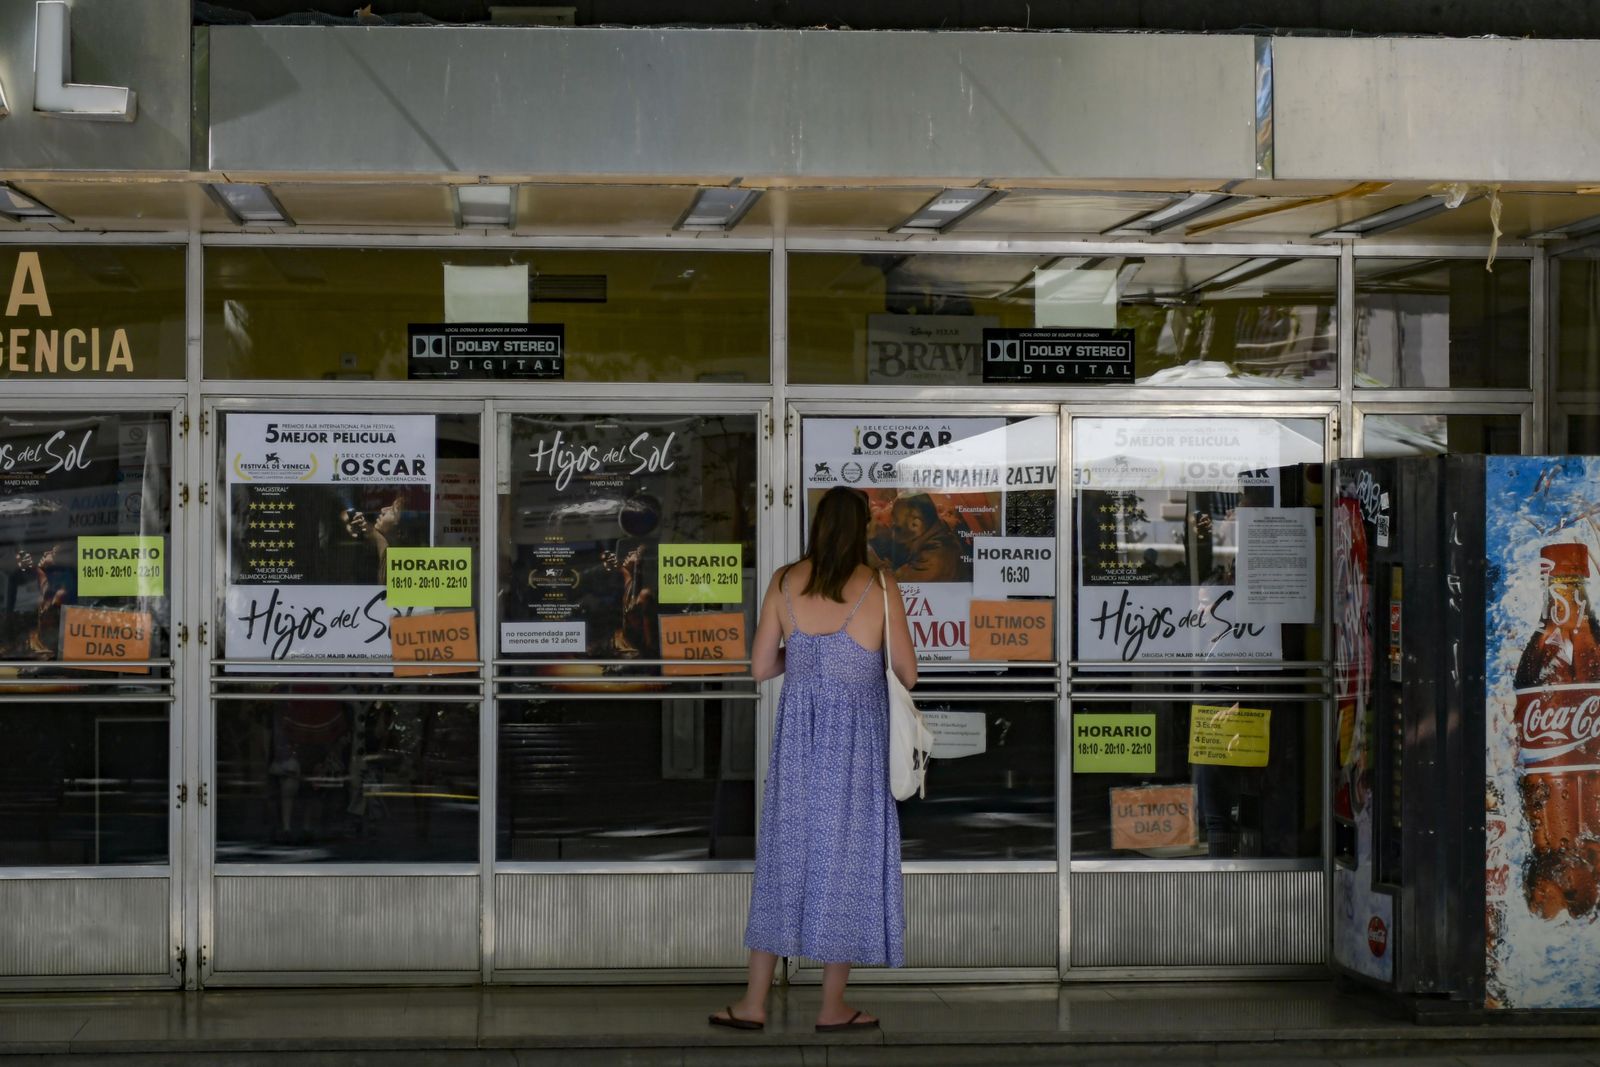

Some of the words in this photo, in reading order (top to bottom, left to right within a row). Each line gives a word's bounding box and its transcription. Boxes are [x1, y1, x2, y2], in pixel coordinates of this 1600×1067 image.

[5, 252, 52, 316] A
[0, 328, 134, 373] ENCIA
[456, 341, 500, 352] DOLBY
[503, 341, 555, 352] STEREO
[1029, 345, 1072, 356] DOLBY
[1076, 346, 1126, 357] STEREO
[450, 360, 560, 370] DIGITAL
[1023, 364, 1131, 375] DIGITAL
[265, 423, 280, 443] 5
[280, 432, 328, 443] MEJOR
[333, 432, 396, 443] PELICULA
[863, 431, 952, 450] OSCAR
[1114, 428, 1128, 447] 5
[1129, 436, 1175, 447] MEJOR
[1179, 436, 1241, 447] PELICULA
[17, 443, 42, 462] del
[44, 430, 93, 474] Sol
[341, 458, 426, 476] OSCAR
[529, 430, 600, 491] Hijos
[602, 445, 626, 463] del
[629, 431, 675, 475] Sol
[82, 548, 160, 560] HORARIO
[977, 548, 1052, 560] HORARIO
[391, 559, 468, 572] HORARIO
[662, 556, 738, 568] HORARIO
[82, 566, 104, 578] 18:10
[110, 566, 132, 578] 20:10
[138, 566, 160, 578] 22:10
[663, 573, 684, 585] 18:10
[690, 573, 712, 585] 20:10
[718, 573, 738, 585] 22:10
[1000, 566, 1030, 583] 16:30
[391, 576, 412, 589] 18:10
[418, 576, 440, 589] 20:10
[446, 576, 468, 589] 22:10
[239, 588, 328, 661] Hijos
[330, 605, 361, 629] del
[974, 615, 1046, 630] ULTIMOS
[1090, 589, 1176, 662] Hijos
[1178, 609, 1206, 629] del
[69, 623, 145, 641] ULTIMOS
[395, 626, 470, 647] ULTIMOS
[666, 627, 739, 646] ULTIMOS
[990, 633, 1029, 646] DIAS
[85, 642, 126, 657] DIAS
[414, 646, 455, 662] DIAS
[684, 645, 724, 661] DIAS
[1078, 726, 1152, 738] HORARIO
[1078, 743, 1098, 755] 18:10
[1104, 743, 1125, 755] 20:10
[1131, 743, 1152, 755] 22:10
[1117, 802, 1189, 819] ULTIMOS
[1134, 820, 1173, 835] DIAS
